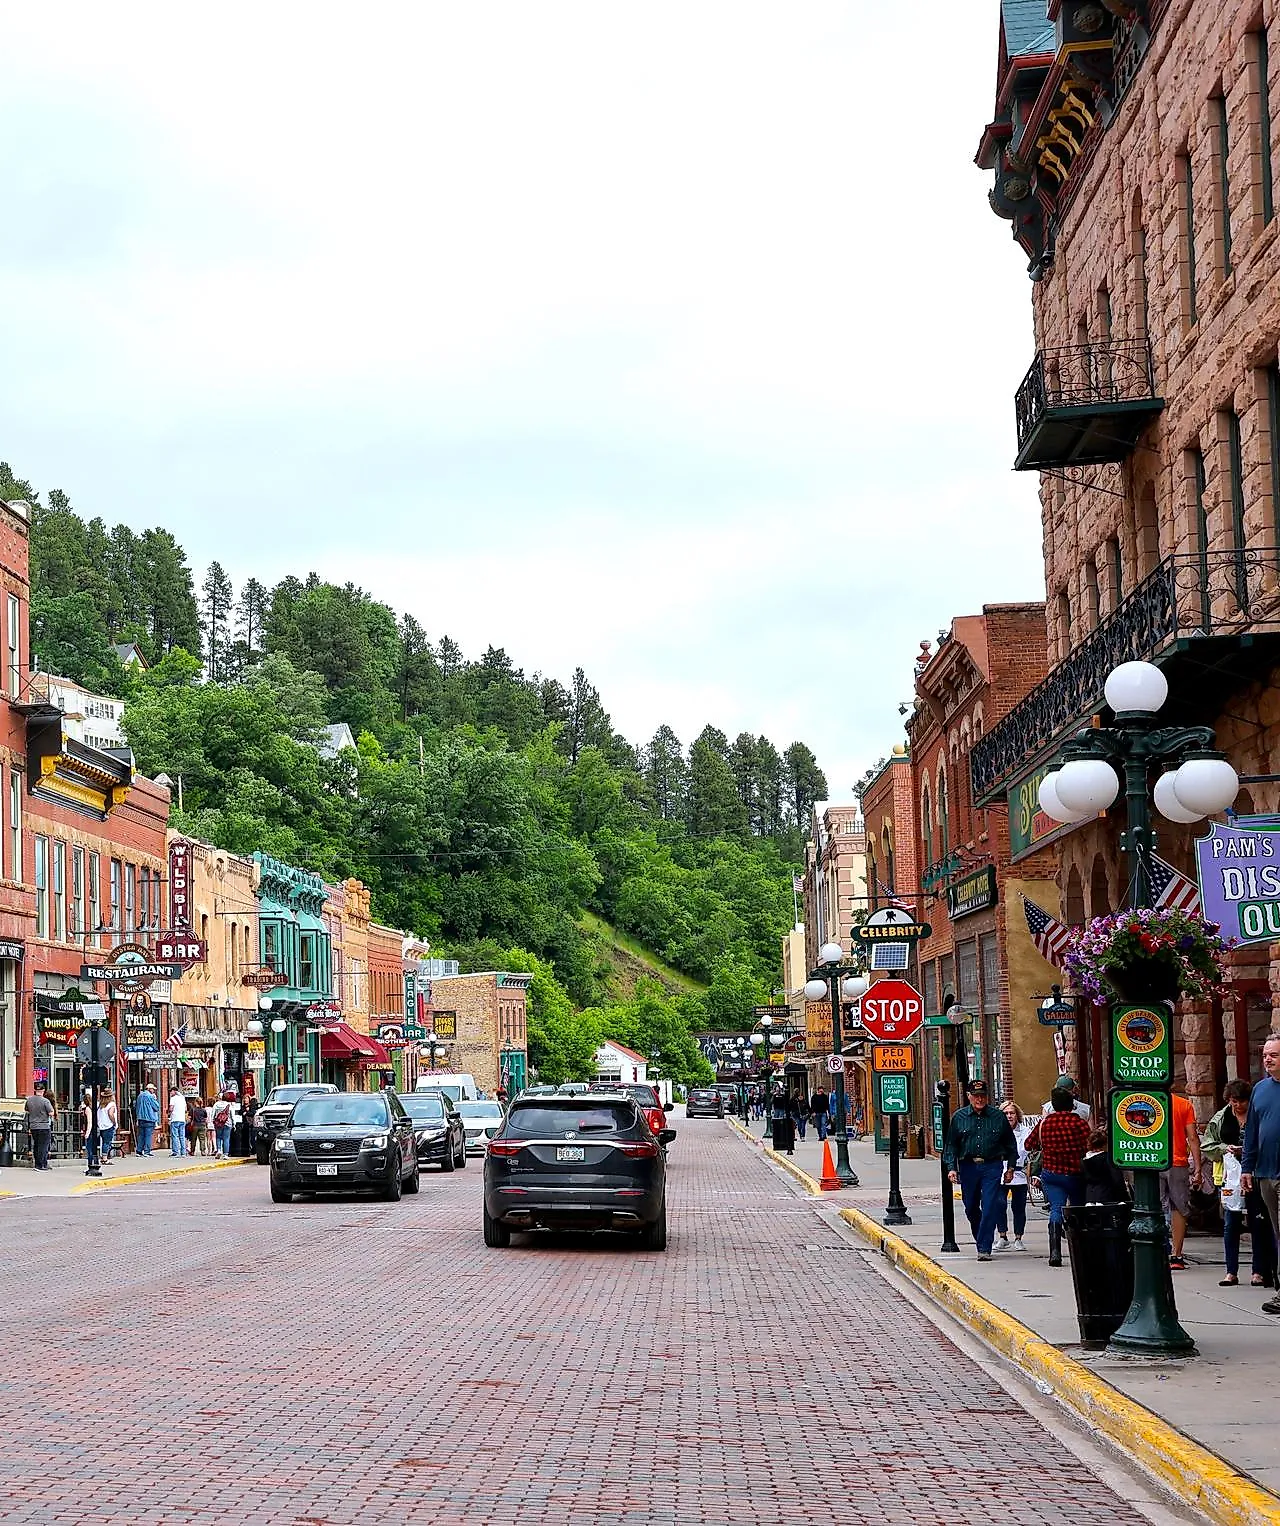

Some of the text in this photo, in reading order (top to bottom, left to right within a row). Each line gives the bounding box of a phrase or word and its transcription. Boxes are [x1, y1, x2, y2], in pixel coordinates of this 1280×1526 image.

[1212, 833, 1274, 858] PAM'S
[174, 846, 187, 889] WILD
[859, 926, 924, 938] CELEBRITY
[161, 944, 201, 959] BAR
[87, 965, 174, 979] RESTAURANT
[118, 984, 145, 993] GAMING
[406, 981, 415, 1025] EAGLE
[864, 999, 919, 1022] STOP
[125, 1013, 156, 1027] TRIAL
[45, 1031, 67, 1041] IRISH
[135, 1030, 153, 1038] JACK
[882, 1048, 904, 1057] PED
[881, 1059, 907, 1068] XING
[1120, 1056, 1163, 1069] STOP
[1118, 1068, 1166, 1078] NO PARKING
[1119, 1140, 1164, 1150] BOARD
[1124, 1152, 1159, 1163] HERE
